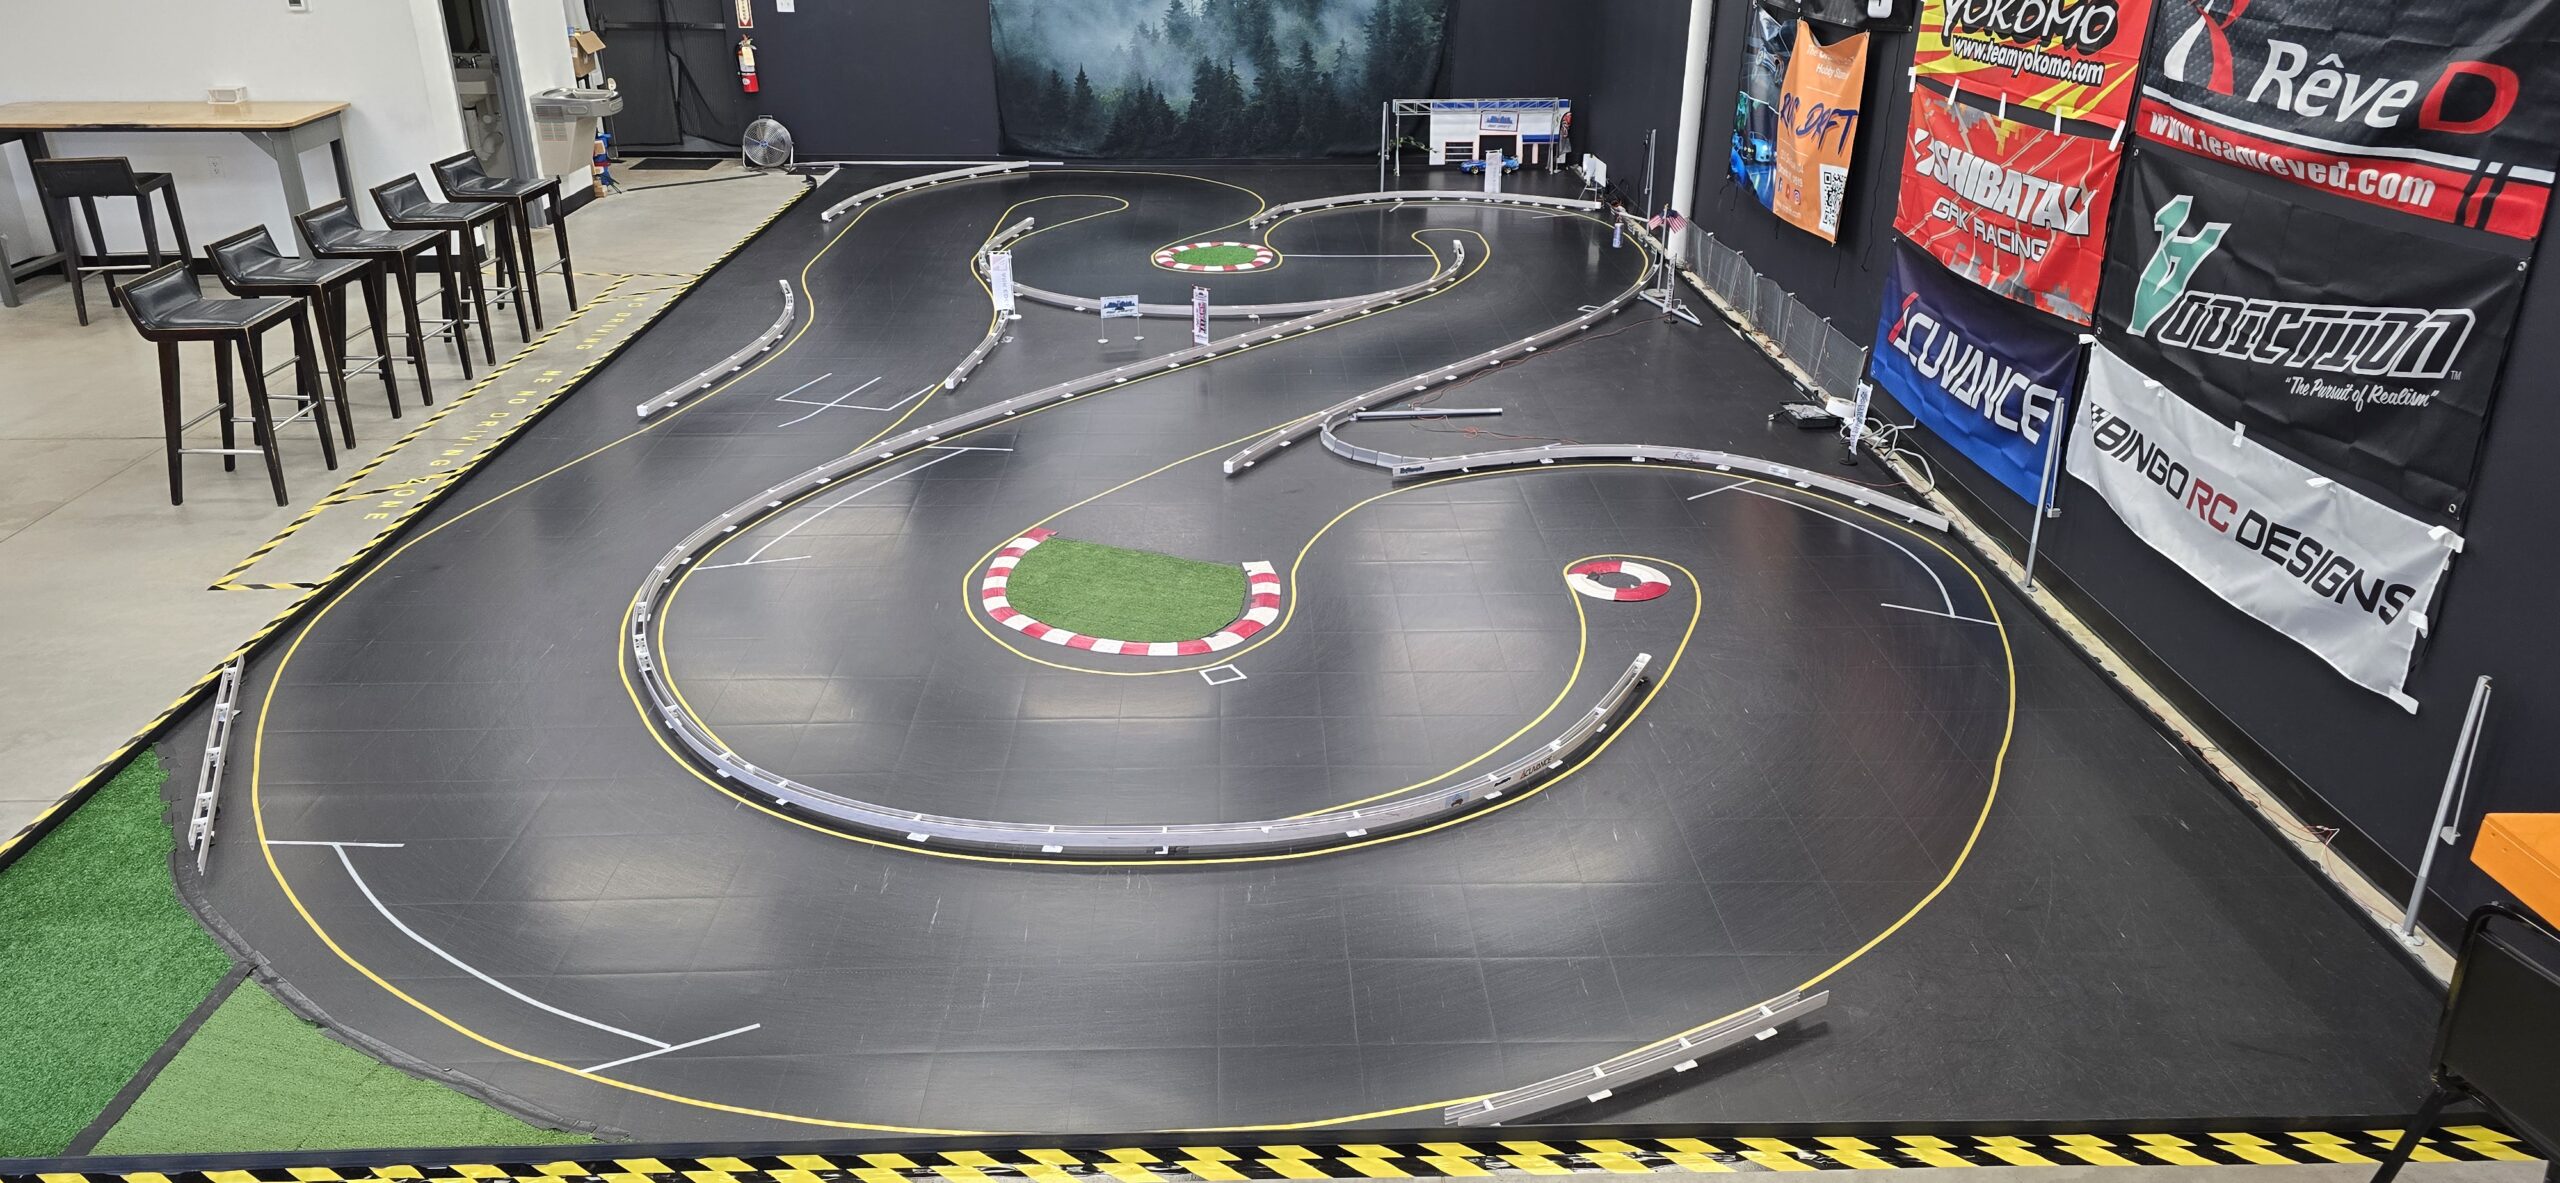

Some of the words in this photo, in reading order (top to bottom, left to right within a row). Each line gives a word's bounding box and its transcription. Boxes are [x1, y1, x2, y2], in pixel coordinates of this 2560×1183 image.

[1943, 0, 2116, 45] YOKOMO
[1952, 36, 2104, 85] www.teamyokomo.com
[2149, 111, 2436, 208] www.teamreved.com
[1973, 216, 2050, 262] RACING
[2310, 377, 2353, 402] Pursuit
[2351, 384, 2370, 413] of
[430, 411, 511, 467] DRIVING
[2093, 416, 2190, 500] BINGO
[2186, 477, 2239, 533] RC
[2235, 508, 2417, 626] DESIGNS
